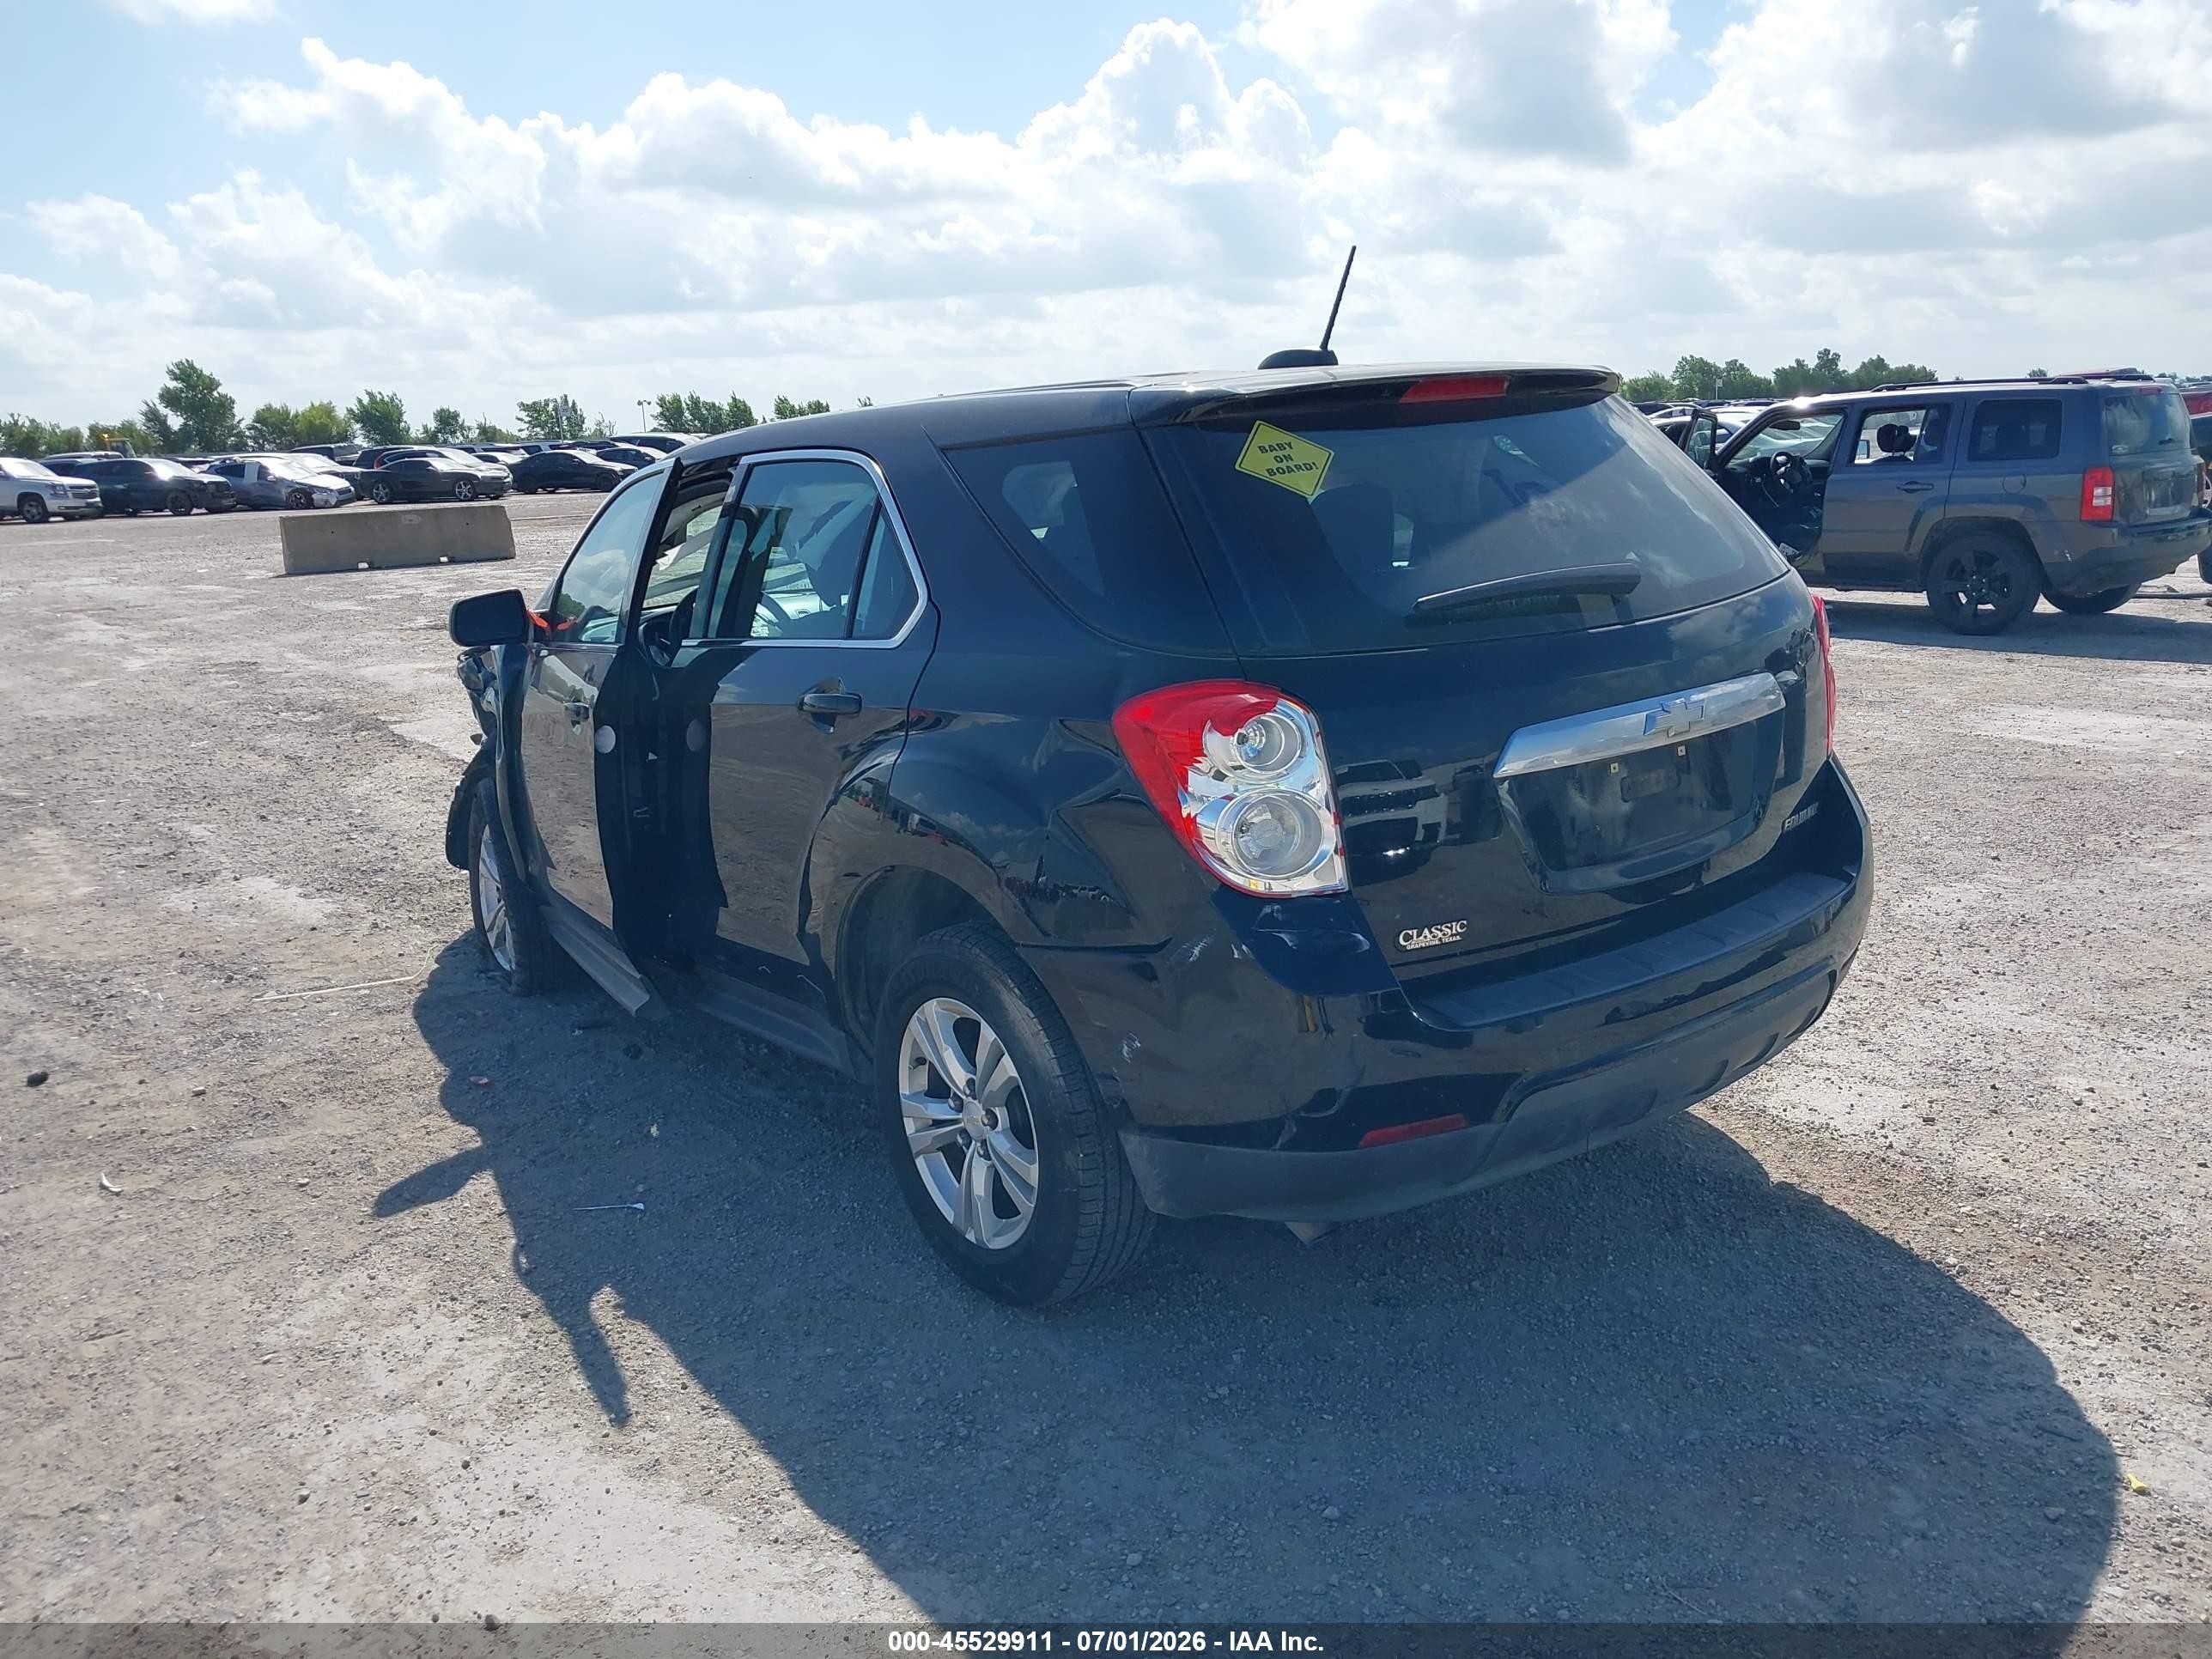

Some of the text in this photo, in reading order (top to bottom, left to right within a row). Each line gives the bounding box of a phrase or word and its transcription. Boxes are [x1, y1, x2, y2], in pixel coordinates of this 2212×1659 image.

[1257, 441, 1293, 453] BABY
[1273, 454, 1294, 463] ON
[1266, 462, 1319, 477] BOARD!
[1399, 921, 1467, 945] CLASSIC
